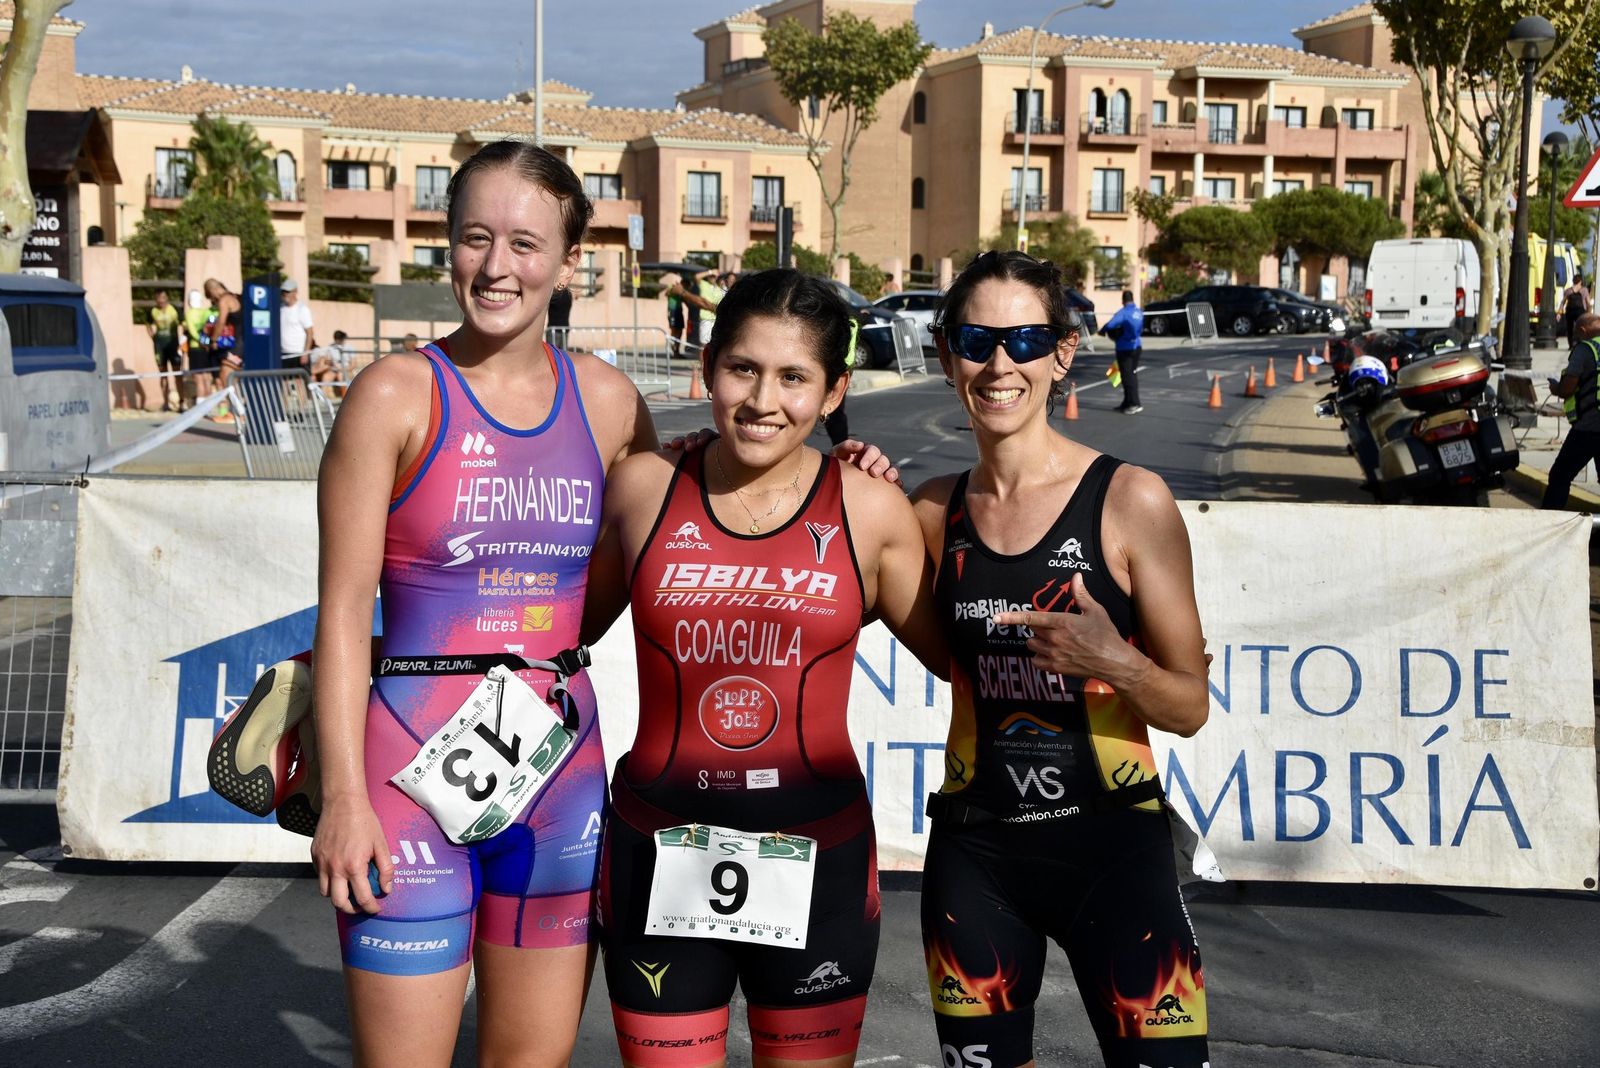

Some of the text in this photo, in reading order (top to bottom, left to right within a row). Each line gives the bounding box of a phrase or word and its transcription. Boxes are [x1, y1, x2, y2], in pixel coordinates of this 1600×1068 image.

[461, 458, 497, 468] mobel
[453, 467, 593, 525] HERNÁNDEZ
[475, 542, 592, 557] TRITRAIN4YOU
[478, 567, 559, 587] Héroes
[658, 563, 838, 598] ISBILYA
[478, 587, 509, 596] HASTA
[484, 607, 515, 617] librería
[653, 592, 837, 616] TRIATHLON TEAM
[476, 616, 518, 632] luces
[675, 618, 802, 667] COAGUILA
[392, 661, 431, 671] PEARL
[979, 655, 1075, 702] SCHENKEL
[1400, 648, 1511, 720] DE
[442, 722, 521, 801] 13
[716, 770, 736, 779] IMD
[394, 867, 454, 876] ación Provincial
[406, 876, 437, 885] Málaga
[709, 861, 749, 915] 9
[662, 914, 792, 936] www.triatlonandalucia.org
[360, 935, 449, 951] STAMINA
